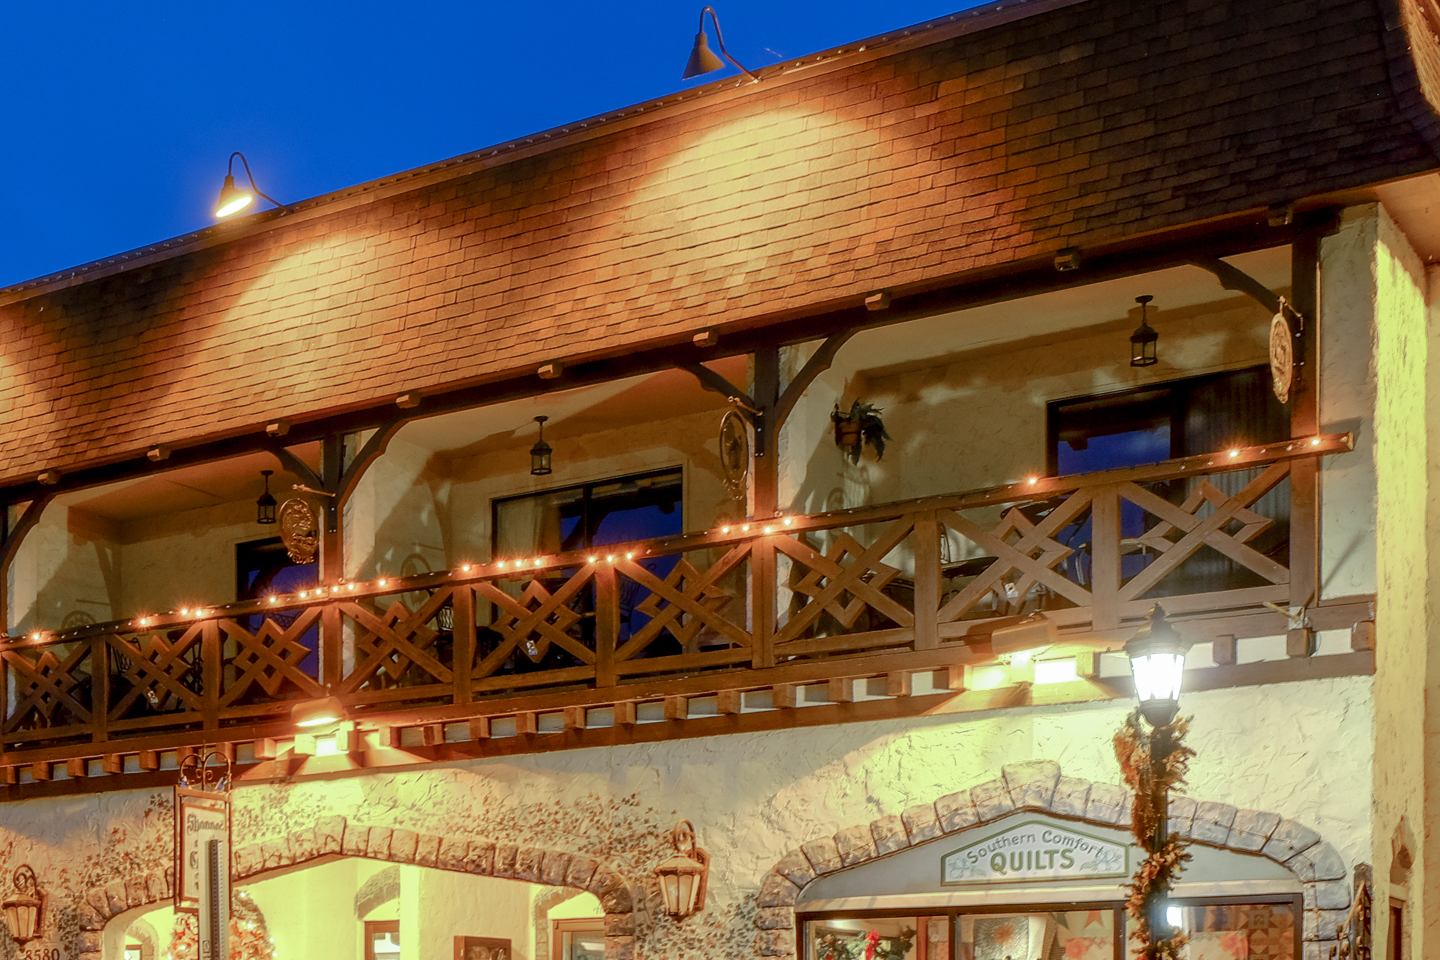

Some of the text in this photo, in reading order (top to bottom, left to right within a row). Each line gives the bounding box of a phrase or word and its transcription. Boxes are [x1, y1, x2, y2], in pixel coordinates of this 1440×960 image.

[966, 829, 1105, 864] Southern Comfort
[990, 848, 1076, 875] QUILTS
